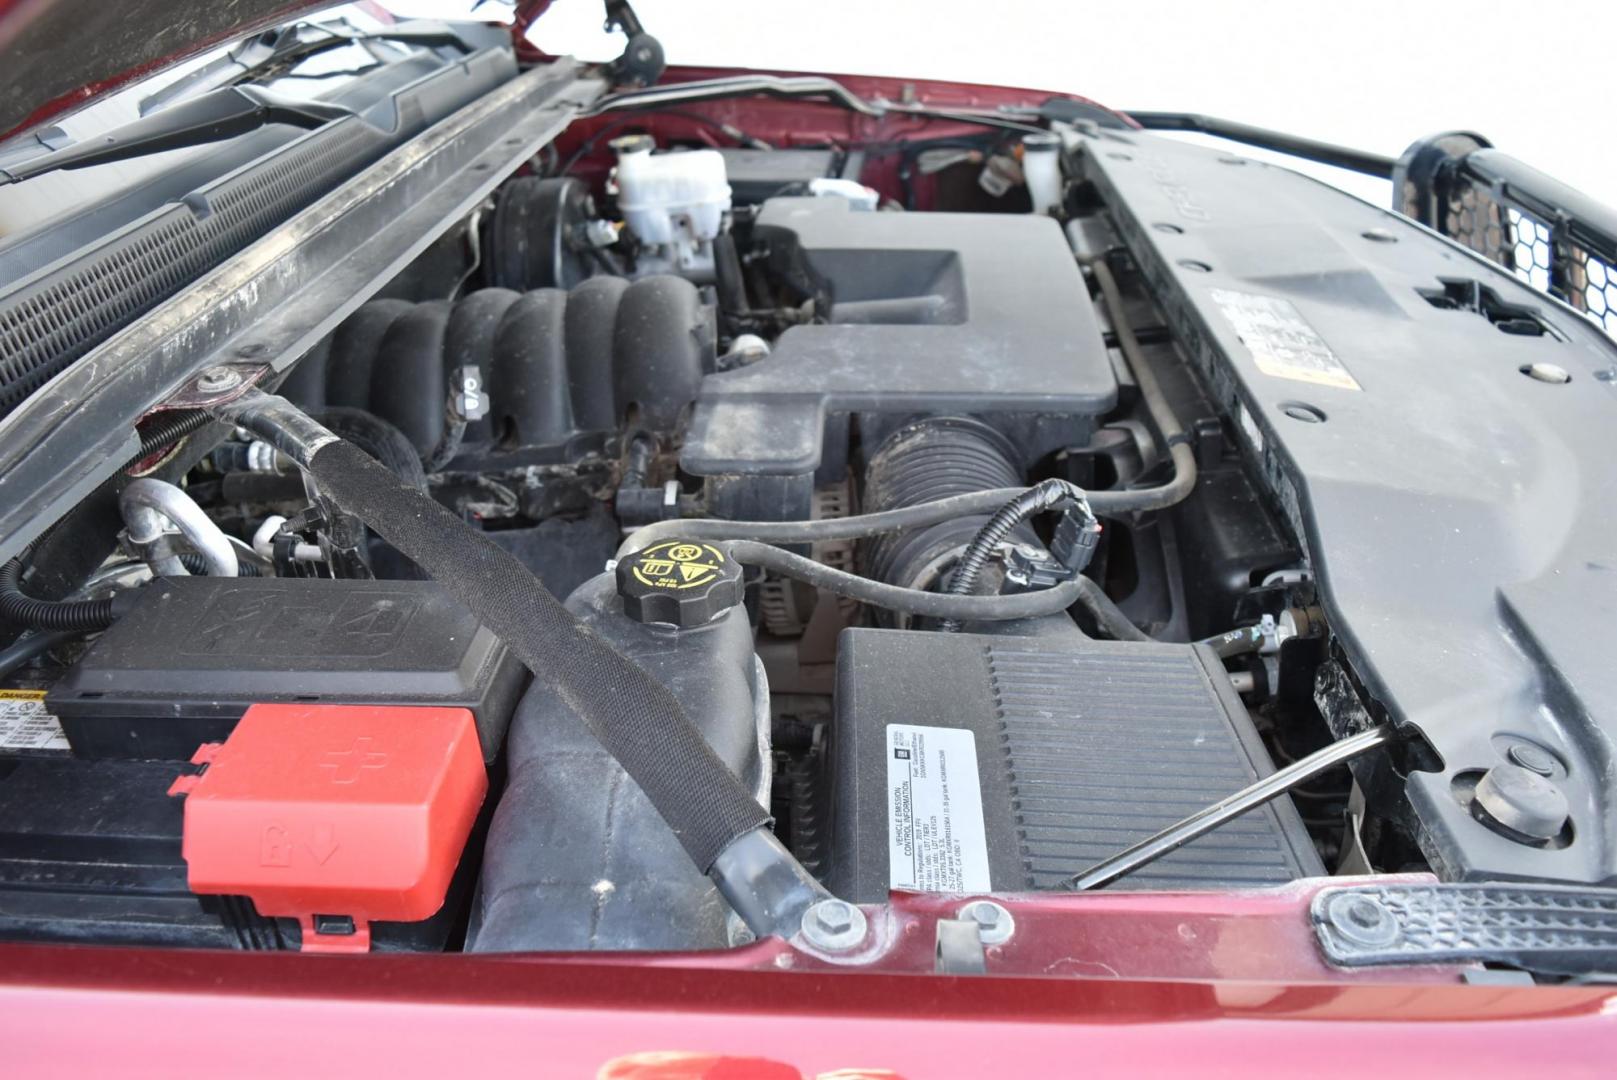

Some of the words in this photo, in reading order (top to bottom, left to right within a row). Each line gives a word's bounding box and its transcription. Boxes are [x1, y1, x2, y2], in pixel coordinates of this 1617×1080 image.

[894, 787, 902, 816] EMISSION
[902, 781, 910, 823] INFORMATION
[904, 824, 912, 856] CONTROL
